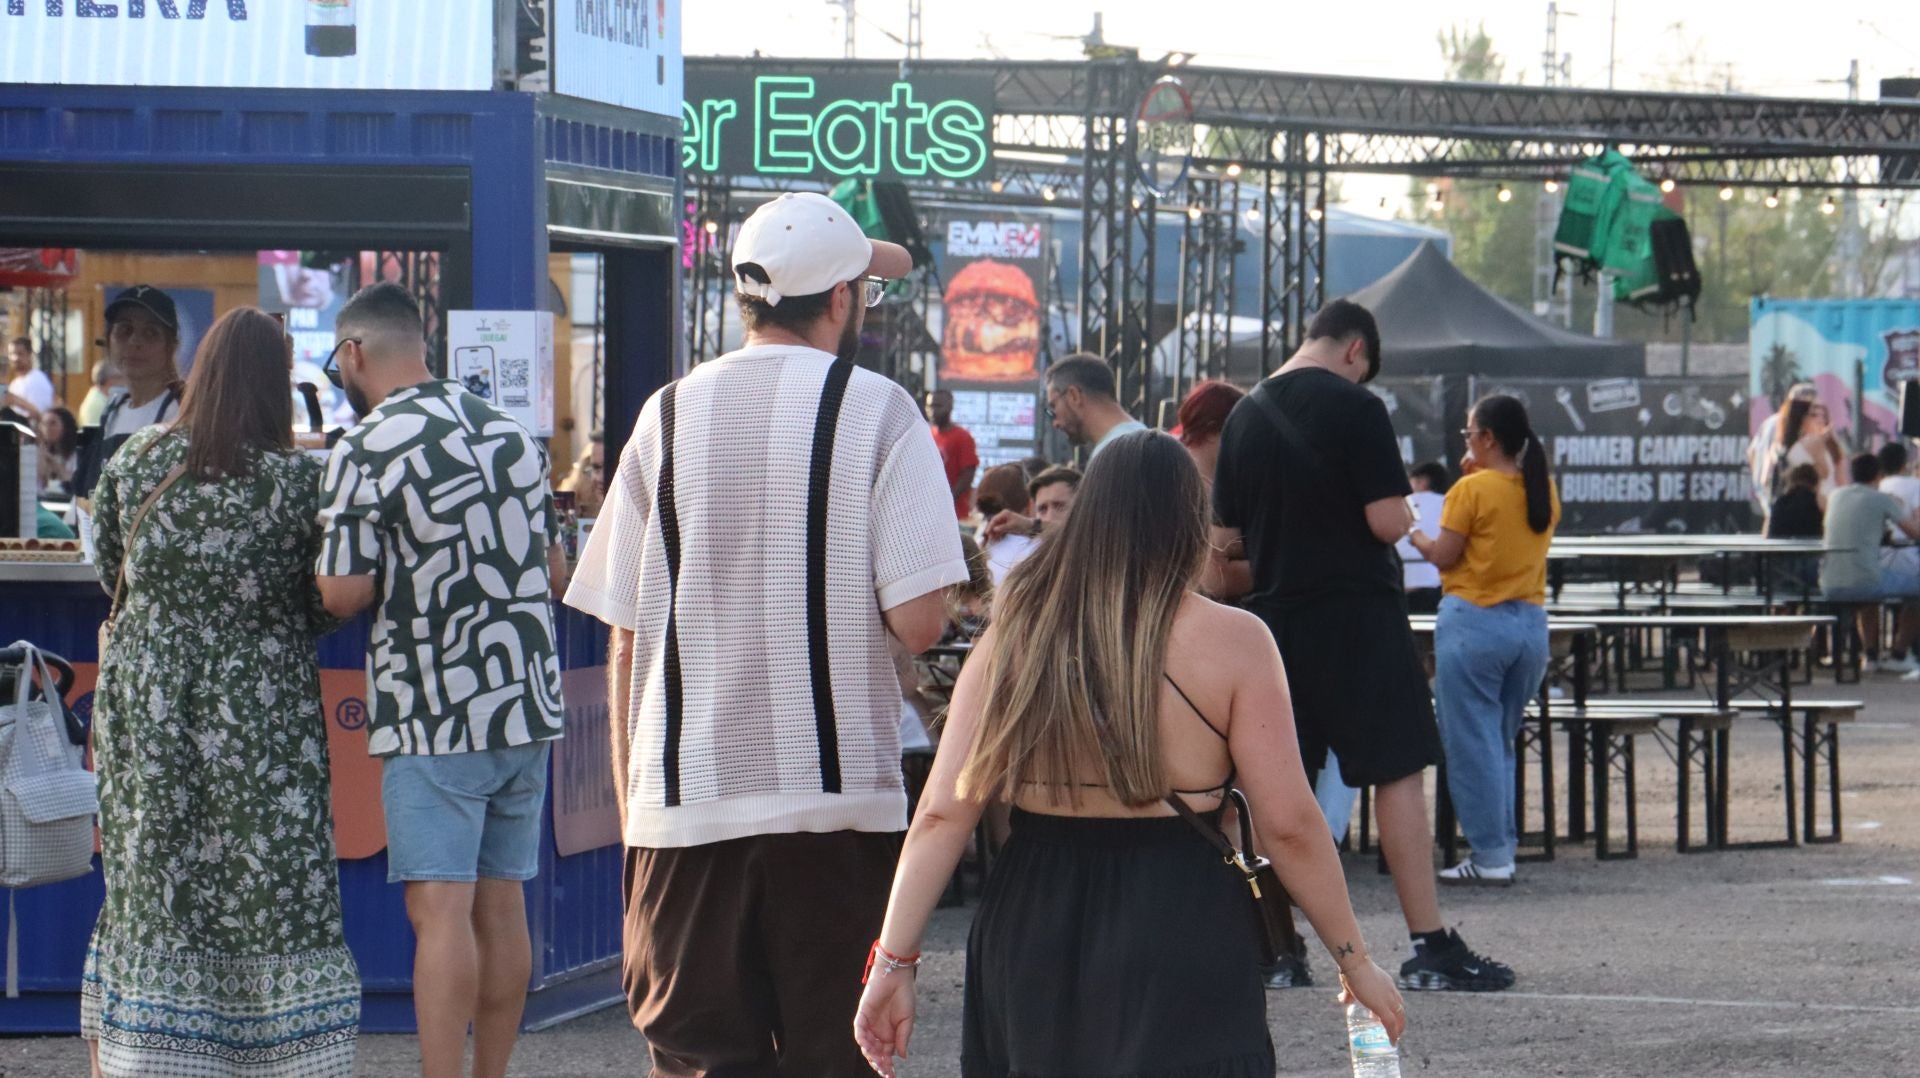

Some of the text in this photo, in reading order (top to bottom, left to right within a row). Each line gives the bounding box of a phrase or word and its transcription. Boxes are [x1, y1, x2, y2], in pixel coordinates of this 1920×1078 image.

[754, 76, 987, 178] Eats
[1554, 435, 1634, 466] PRIMER
[1562, 473, 1654, 502] BURGERS
[1659, 473, 1686, 501] DE
